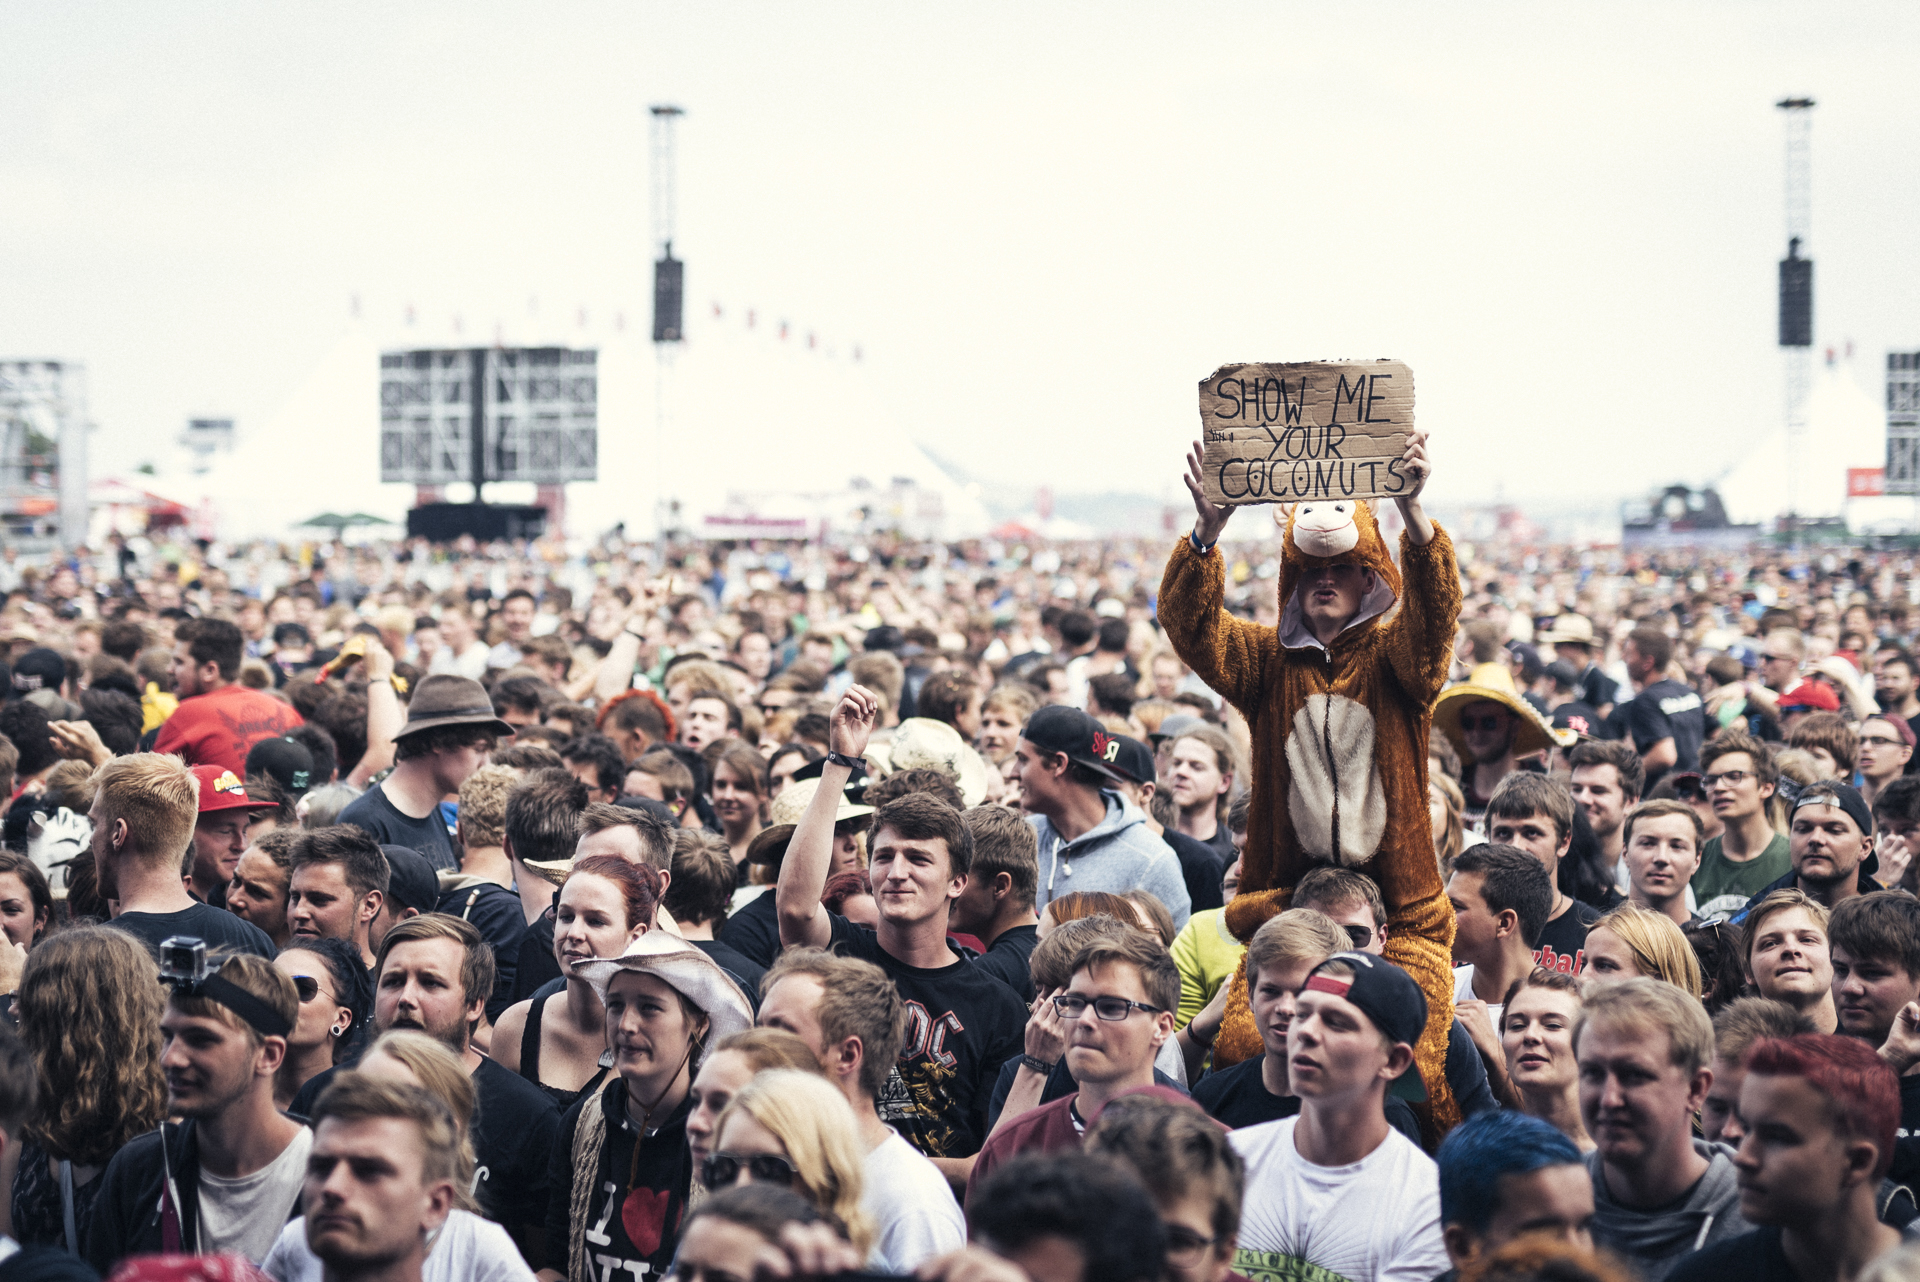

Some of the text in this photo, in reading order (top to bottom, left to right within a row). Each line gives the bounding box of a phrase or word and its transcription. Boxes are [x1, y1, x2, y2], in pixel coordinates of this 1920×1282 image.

[1214, 373, 1393, 425] SHOW ME
[1261, 421, 1347, 461] YOUR
[1218, 456, 1407, 499] COCONUTS
